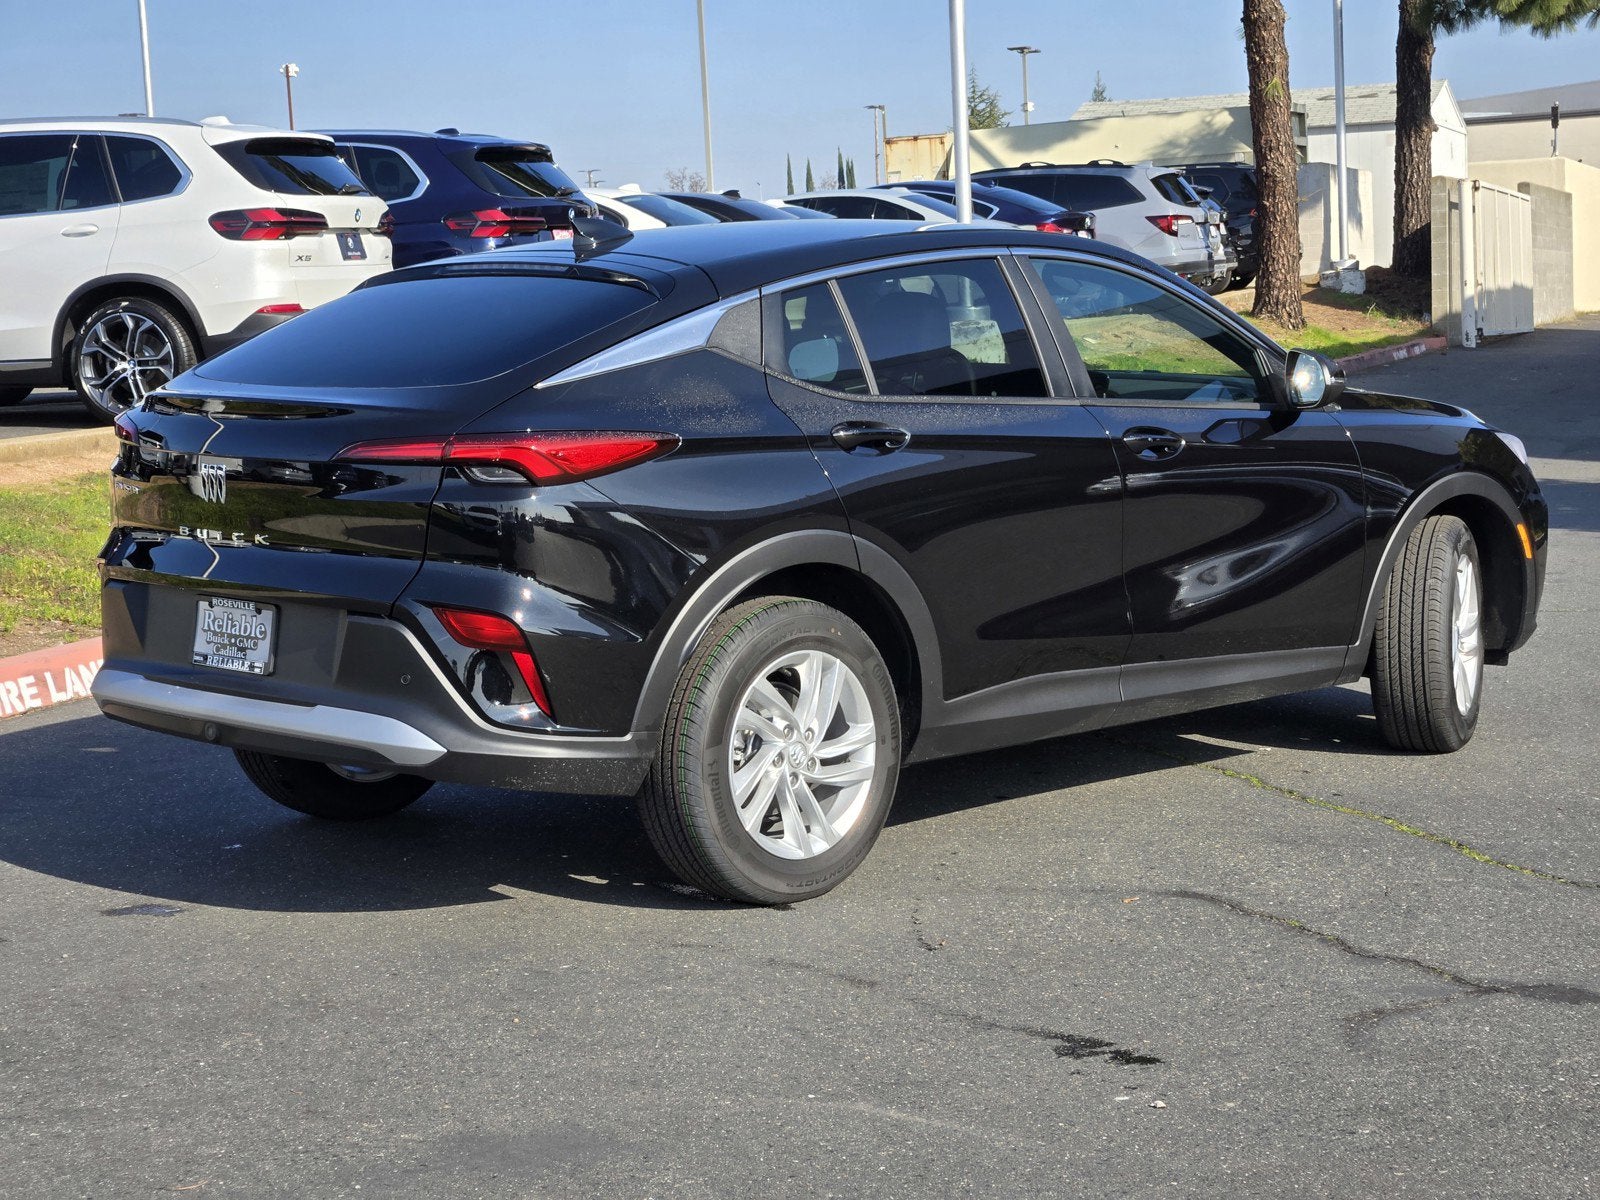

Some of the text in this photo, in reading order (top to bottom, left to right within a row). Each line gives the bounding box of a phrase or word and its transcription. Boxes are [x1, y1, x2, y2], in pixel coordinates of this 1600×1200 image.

[179, 525, 270, 546] BUICK
[212, 598, 255, 611] ROSEVILLE
[202, 609, 266, 639] Reliable
[207, 631, 259, 649] Buick GMC
[213, 644, 247, 659] Cadillac
[206, 655, 251, 671] RELIABLE
